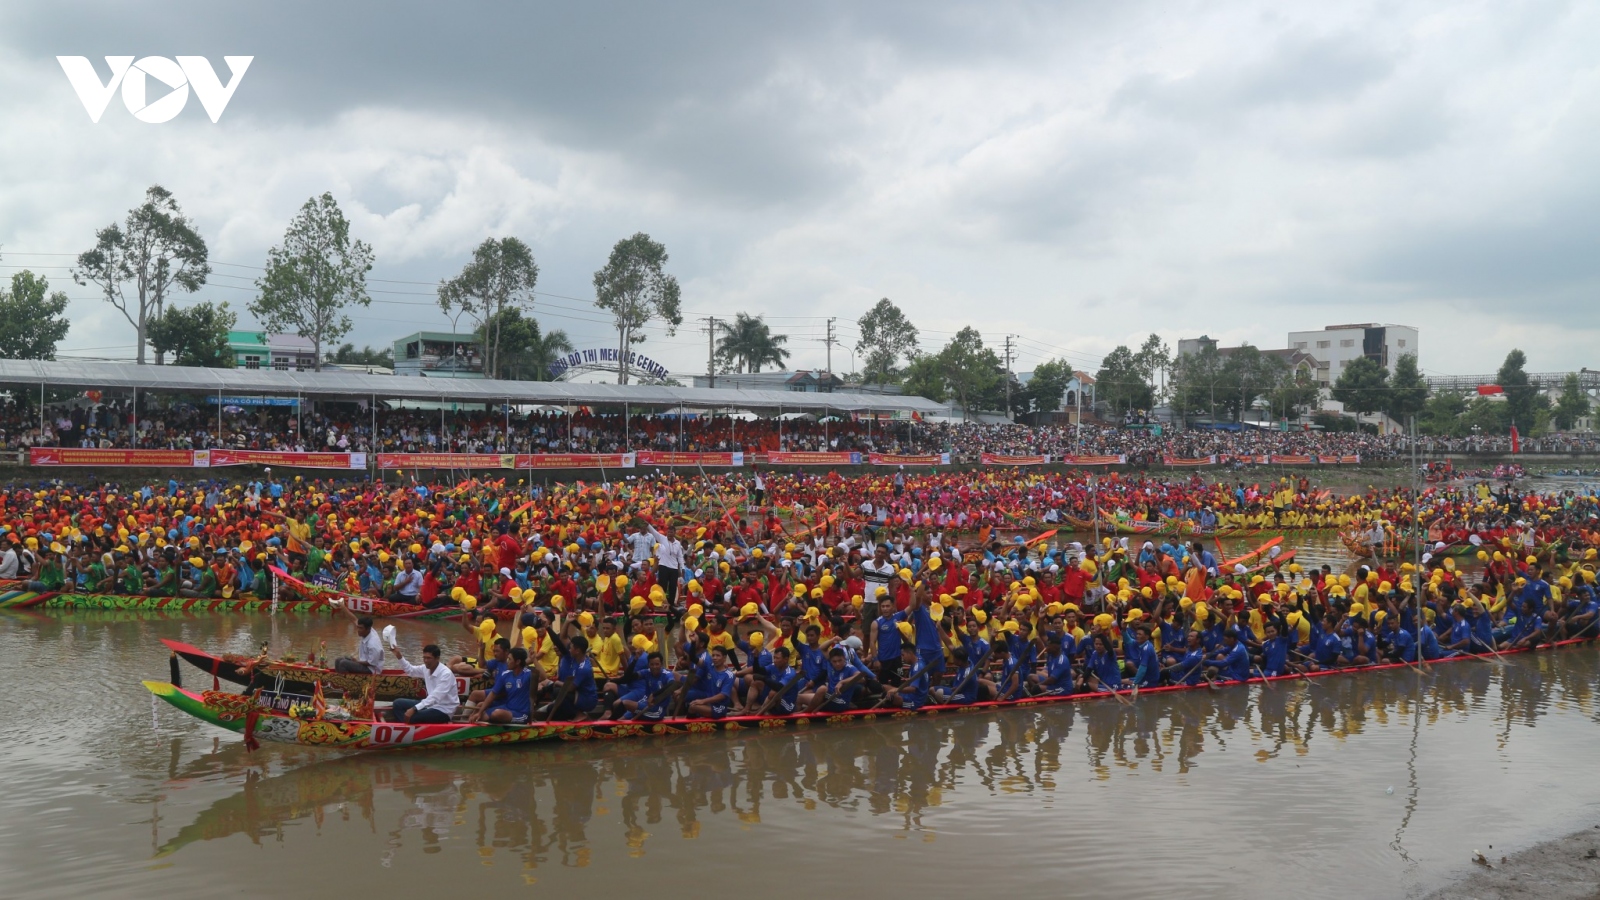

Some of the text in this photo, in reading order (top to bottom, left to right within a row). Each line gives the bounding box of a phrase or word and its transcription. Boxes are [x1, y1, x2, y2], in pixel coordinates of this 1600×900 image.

[582, 348, 597, 363] THỊ
[600, 348, 636, 364] MEKG
[637, 354, 669, 380] CENTRE
[352, 599, 370, 611] 15
[374, 726, 410, 744] 07
